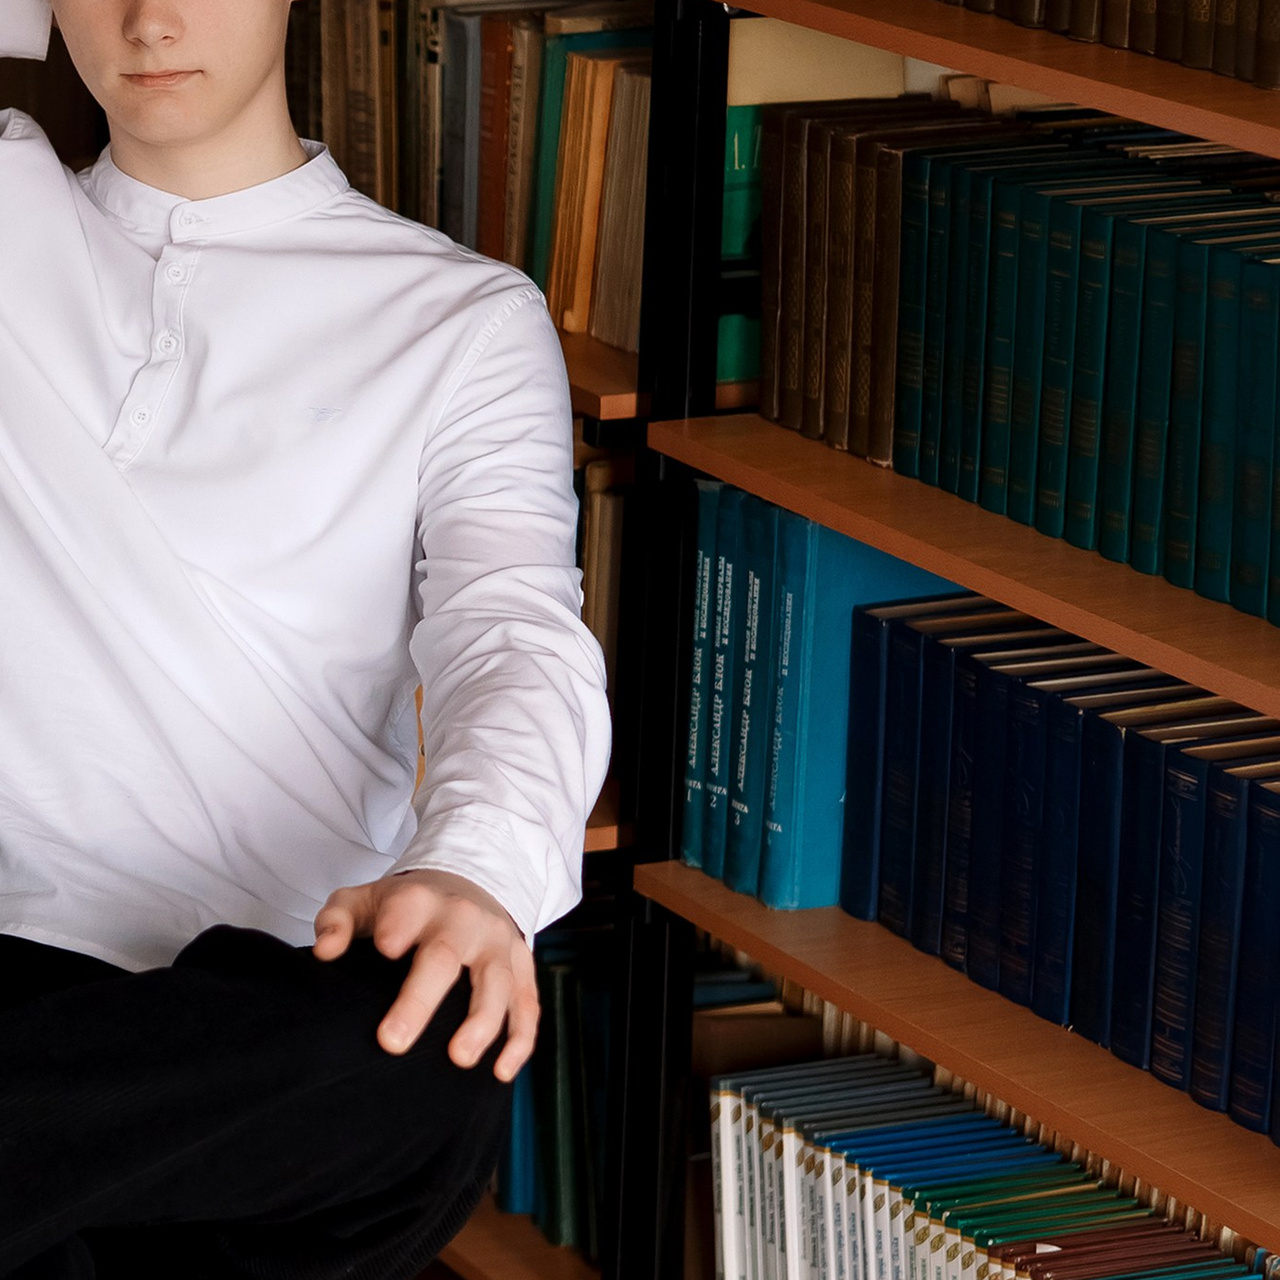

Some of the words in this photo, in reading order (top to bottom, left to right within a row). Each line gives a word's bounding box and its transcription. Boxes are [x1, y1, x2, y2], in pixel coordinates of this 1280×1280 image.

[691, 647, 702, 685] БЛОК
[713, 653, 724, 691] БЛОК
[742, 667, 752, 707] БЛОК
[773, 685, 784, 725] БЛОК
[688, 688, 701, 770] АЛЕКСАНДР
[710, 694, 723, 776] АЛЕКСАНДР
[736, 709, 750, 793] АЛЕКСАНДР
[687, 789, 692, 803] 1
[710, 794, 717, 808] 2
[734, 812, 740, 826] 3
